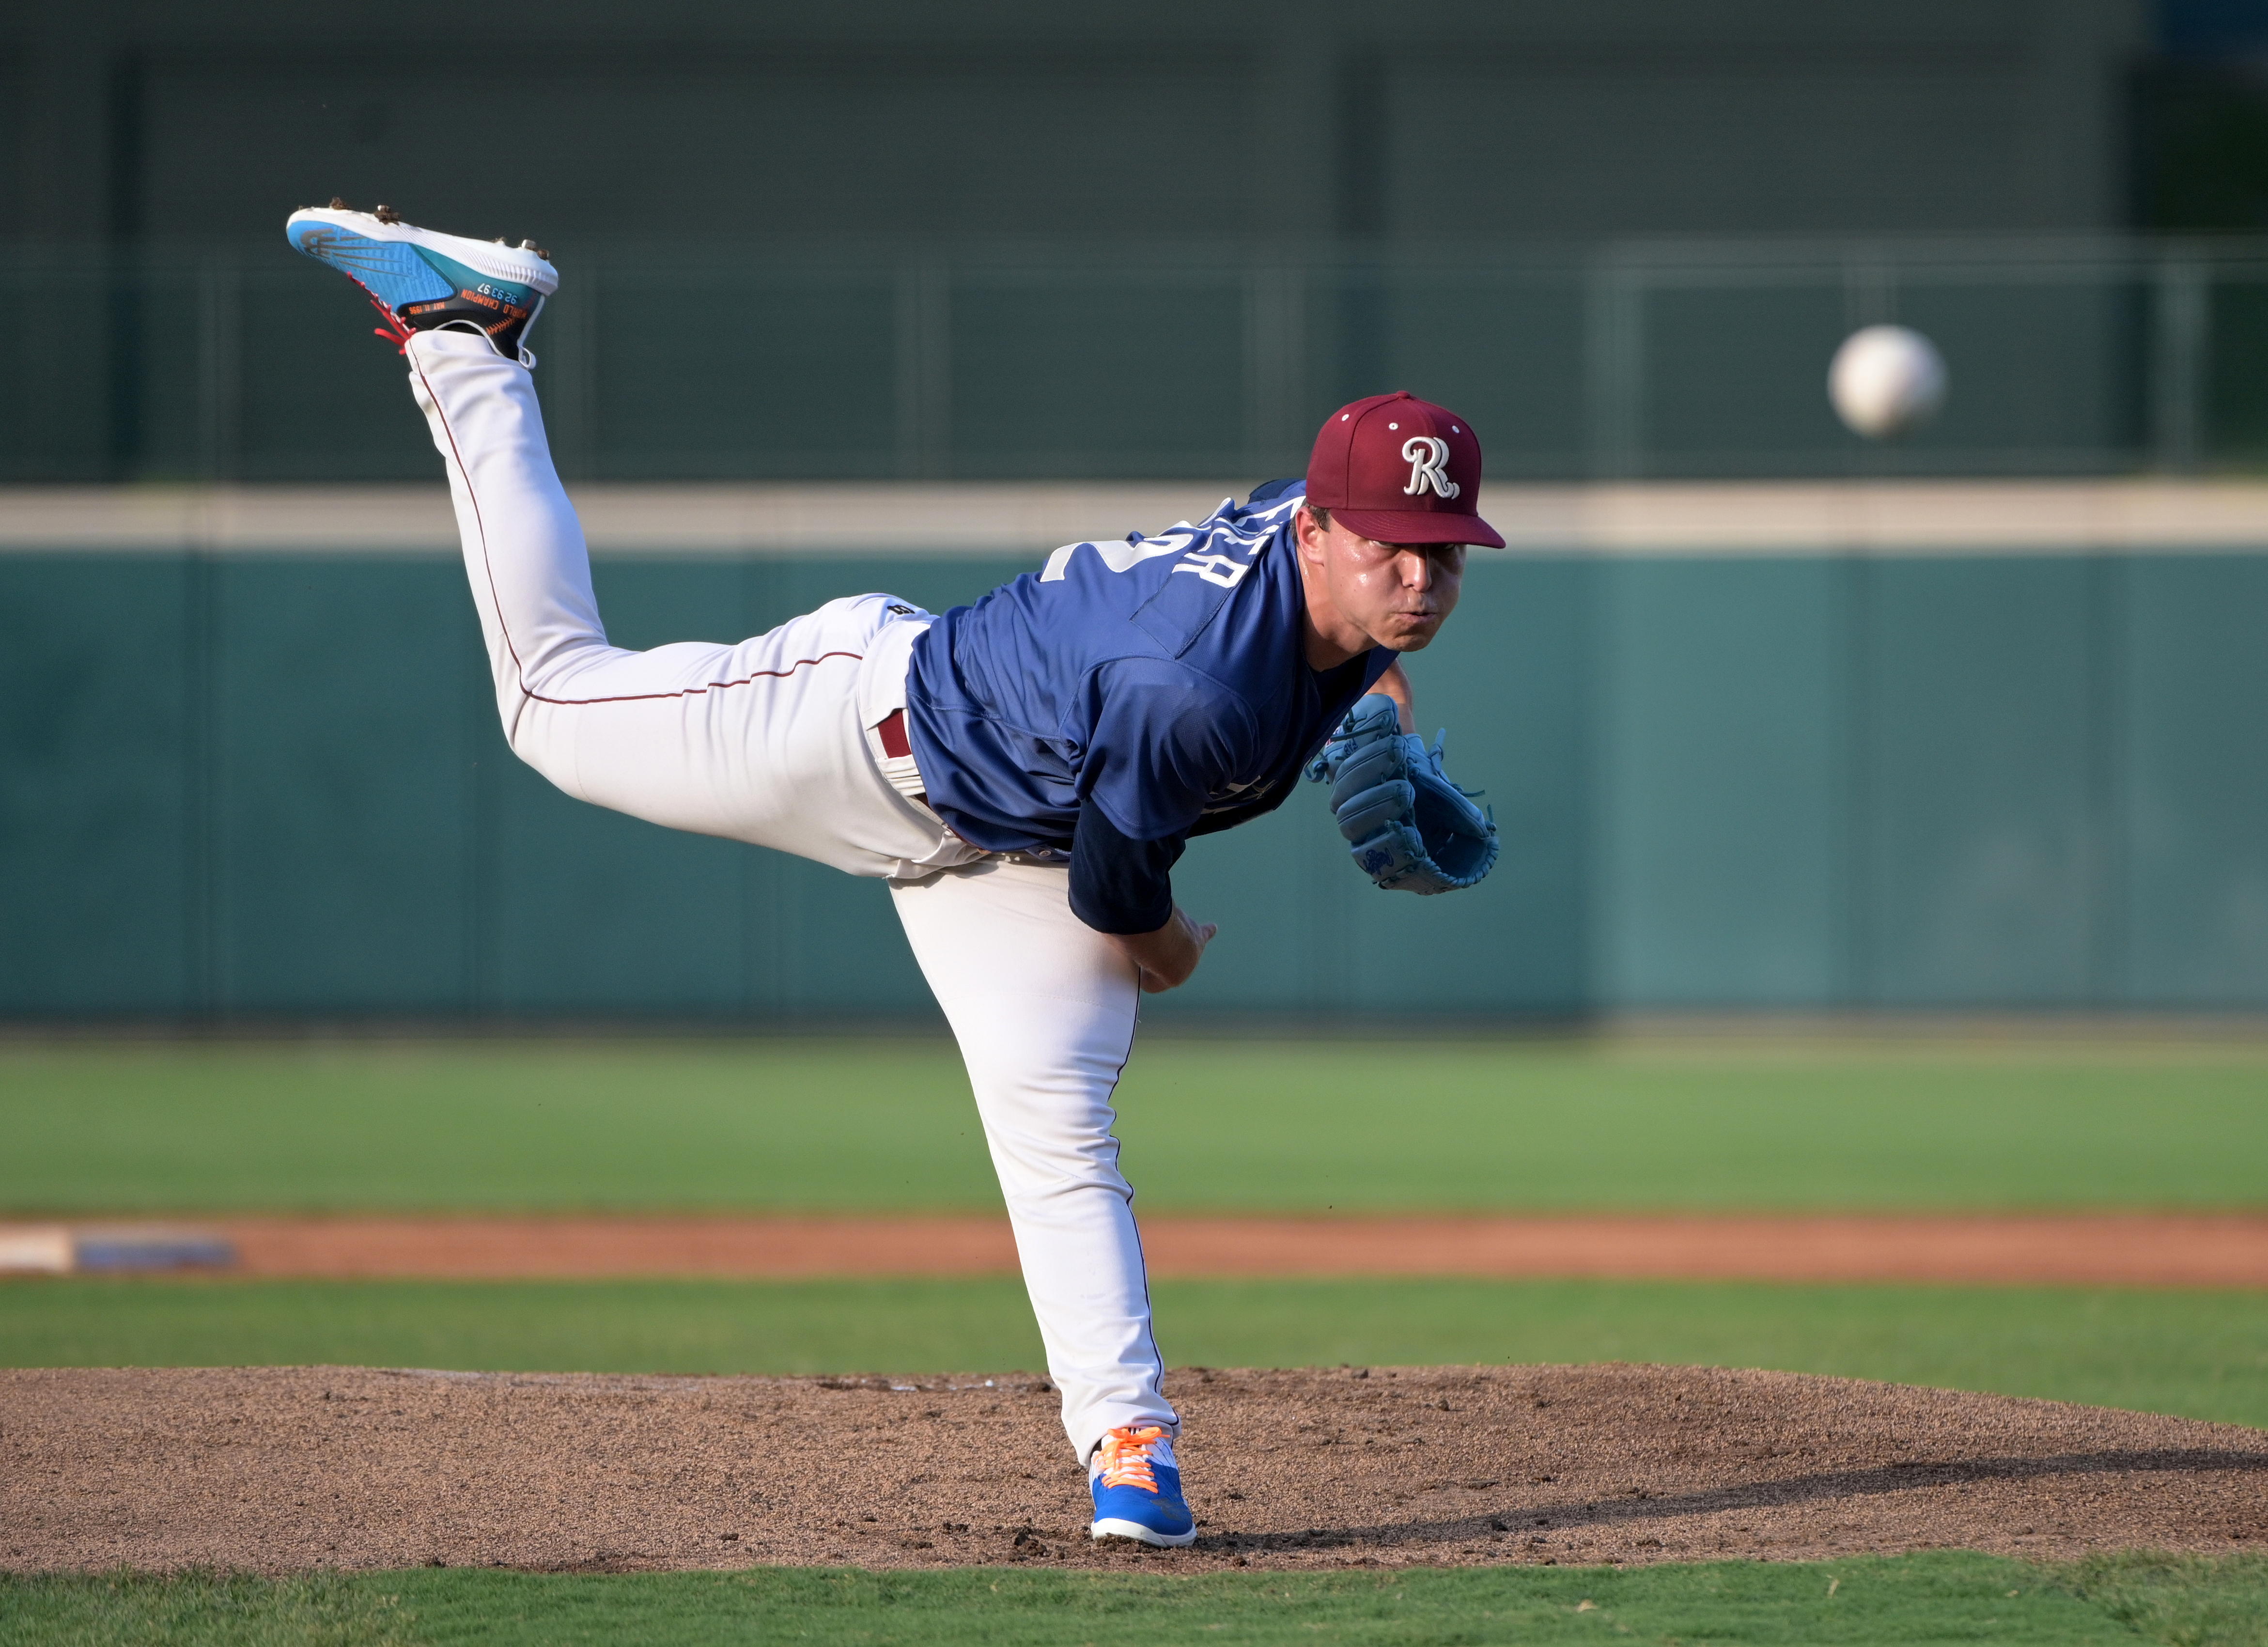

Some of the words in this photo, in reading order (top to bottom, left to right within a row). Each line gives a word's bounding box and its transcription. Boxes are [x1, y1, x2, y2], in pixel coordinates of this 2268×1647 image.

[477, 283, 491, 294] 97
[491, 287, 504, 300] 93
[461, 289, 499, 310] CHAMPION
[505, 292, 518, 304] 92
[409, 305, 423, 314] 1996
[434, 301, 445, 310] MAY
[1402, 436, 1460, 499] R
